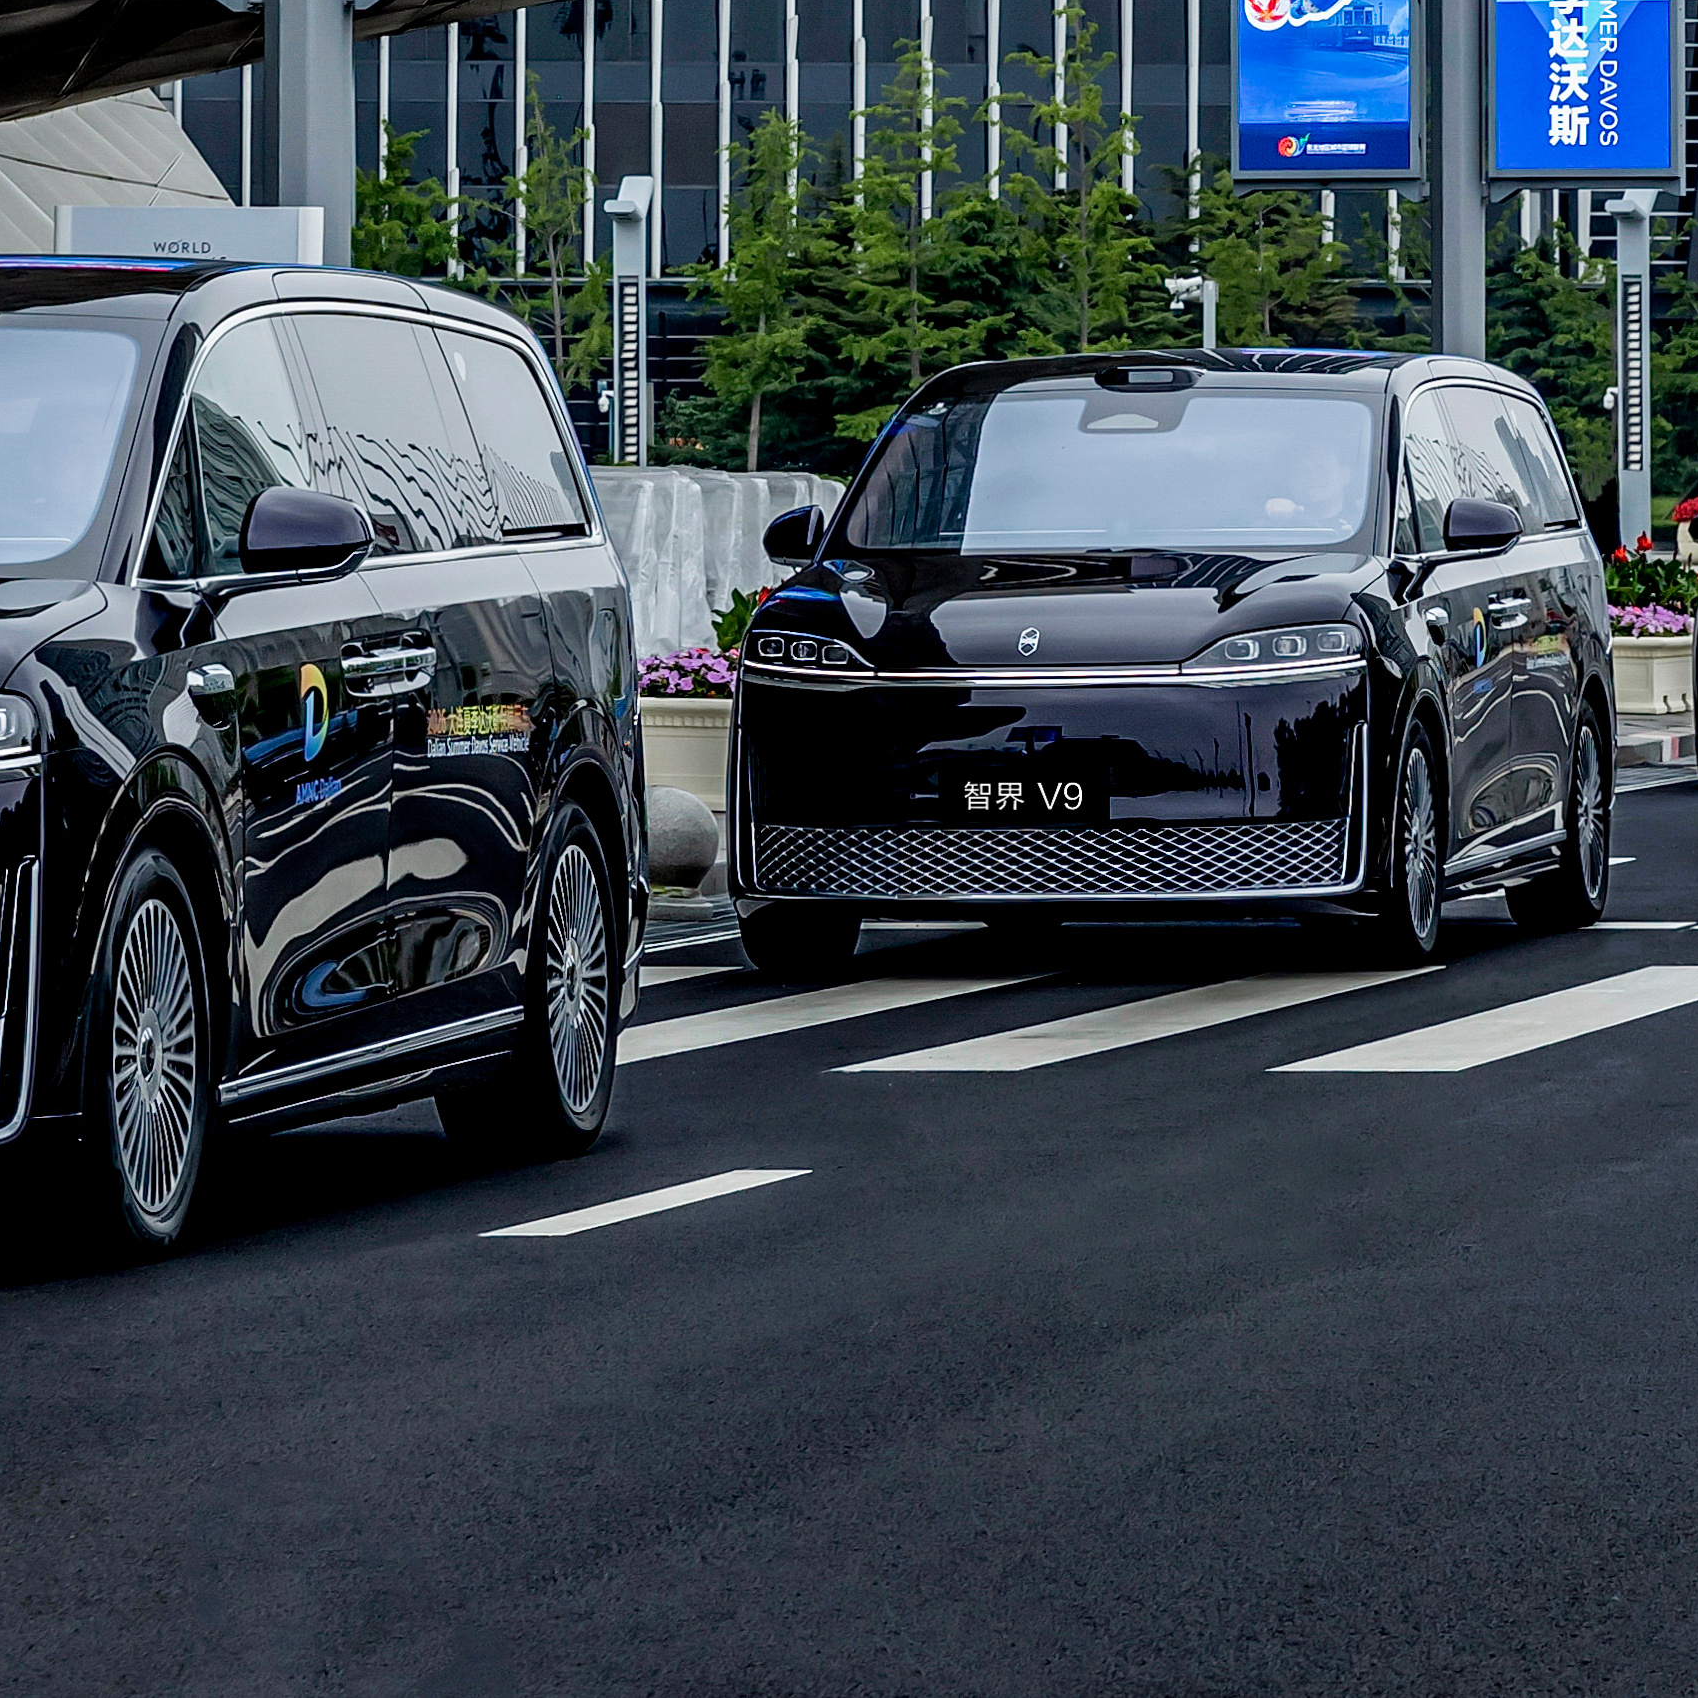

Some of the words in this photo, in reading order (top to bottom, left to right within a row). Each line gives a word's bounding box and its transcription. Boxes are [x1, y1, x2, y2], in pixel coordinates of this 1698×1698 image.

[1599, 60, 1618, 146] DAVOS
[153, 241, 211, 254] WORLD
[964, 781, 1025, 811] 智界
[1036, 782, 1083, 811] V9
